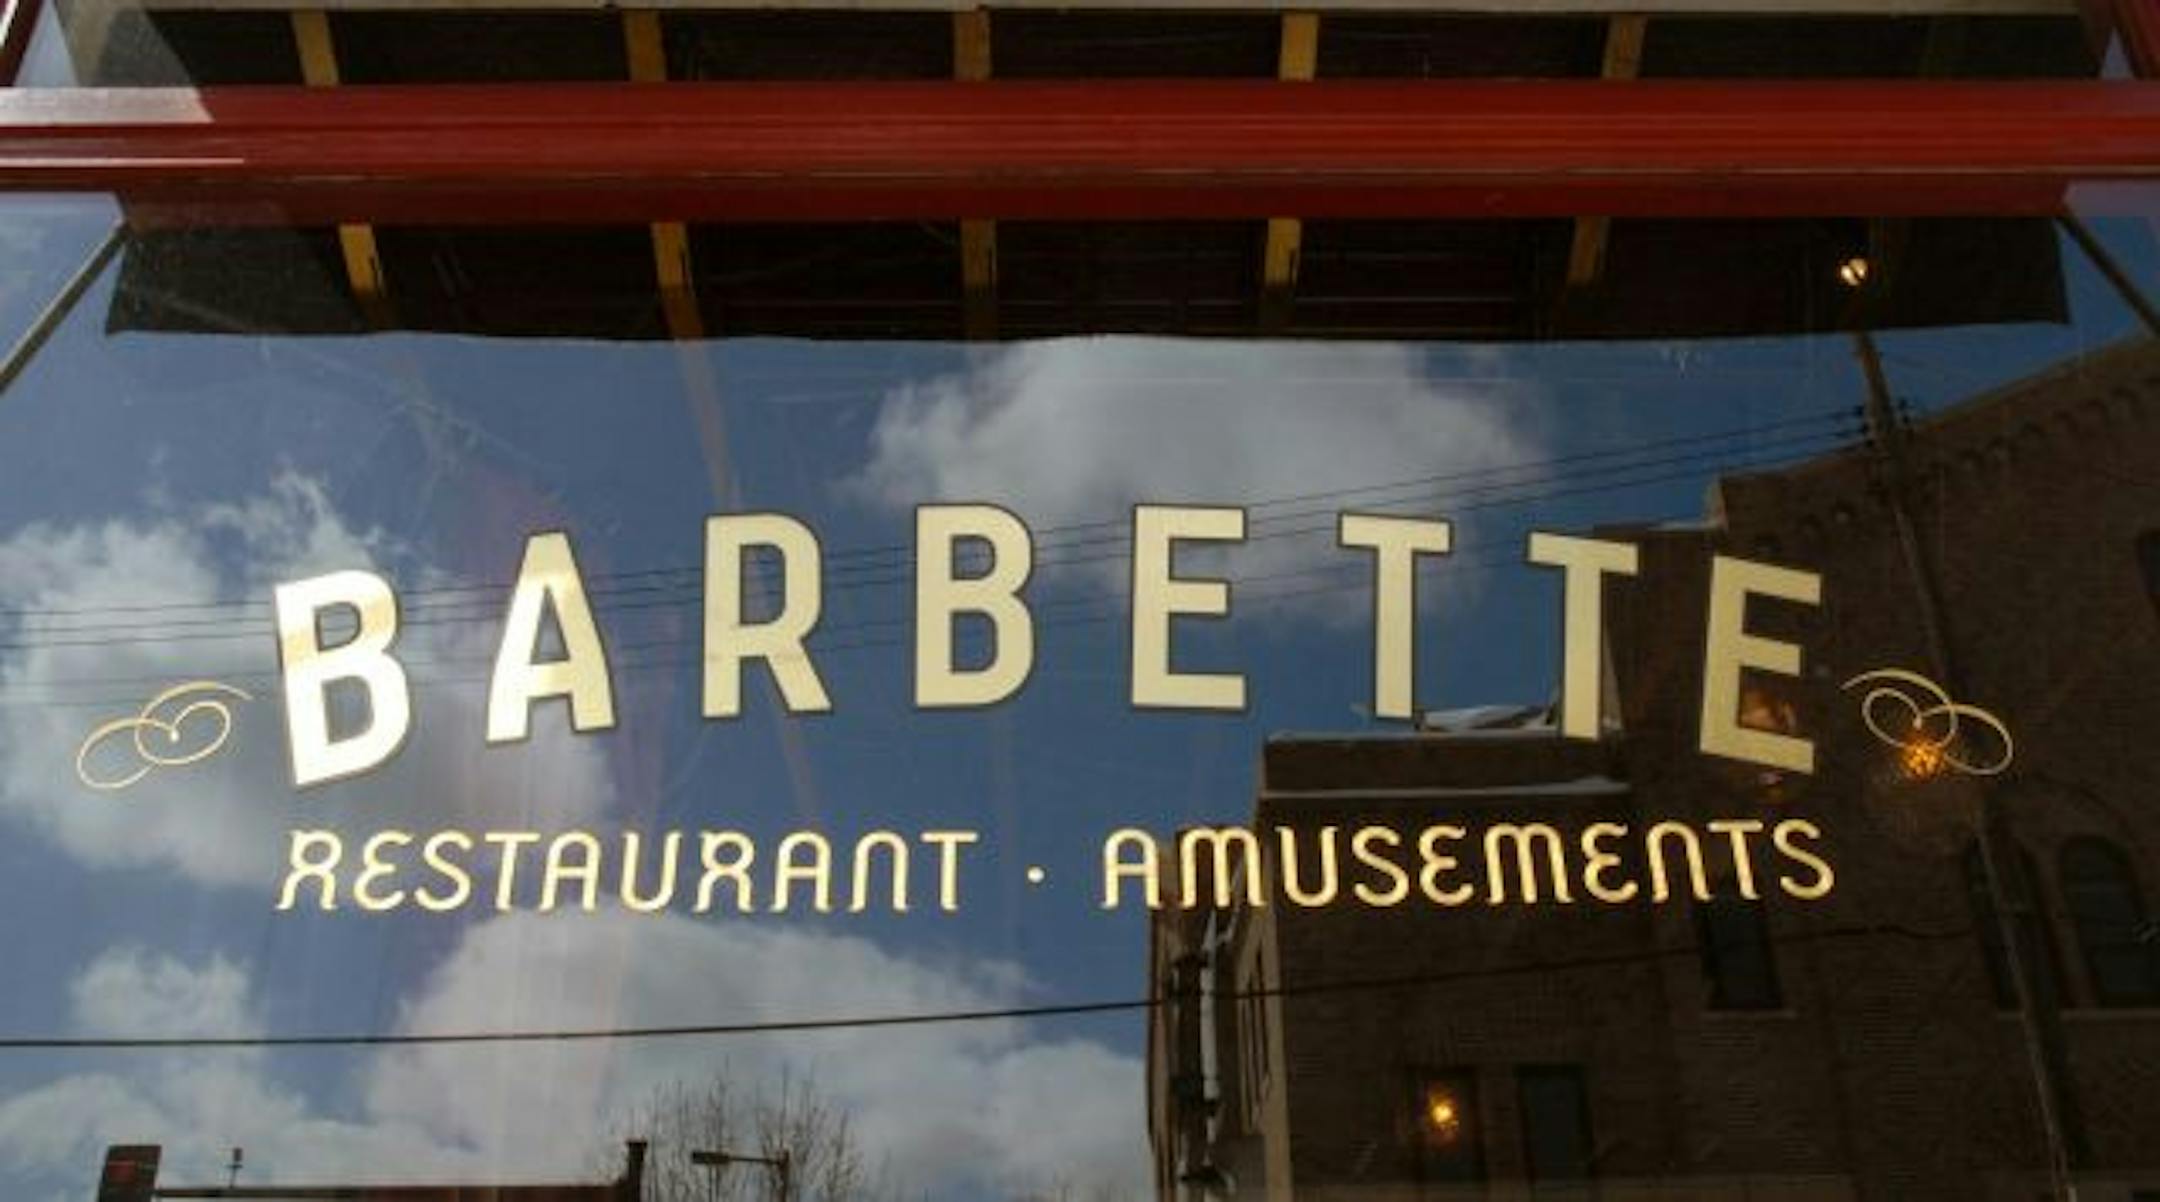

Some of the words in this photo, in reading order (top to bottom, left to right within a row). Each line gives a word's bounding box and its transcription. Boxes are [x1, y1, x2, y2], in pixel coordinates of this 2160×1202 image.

[274, 503, 1823, 788] BARBETTE
[276, 829, 979, 912] RESTAURANT
[1101, 818, 1835, 910] AMUSEMENTS
